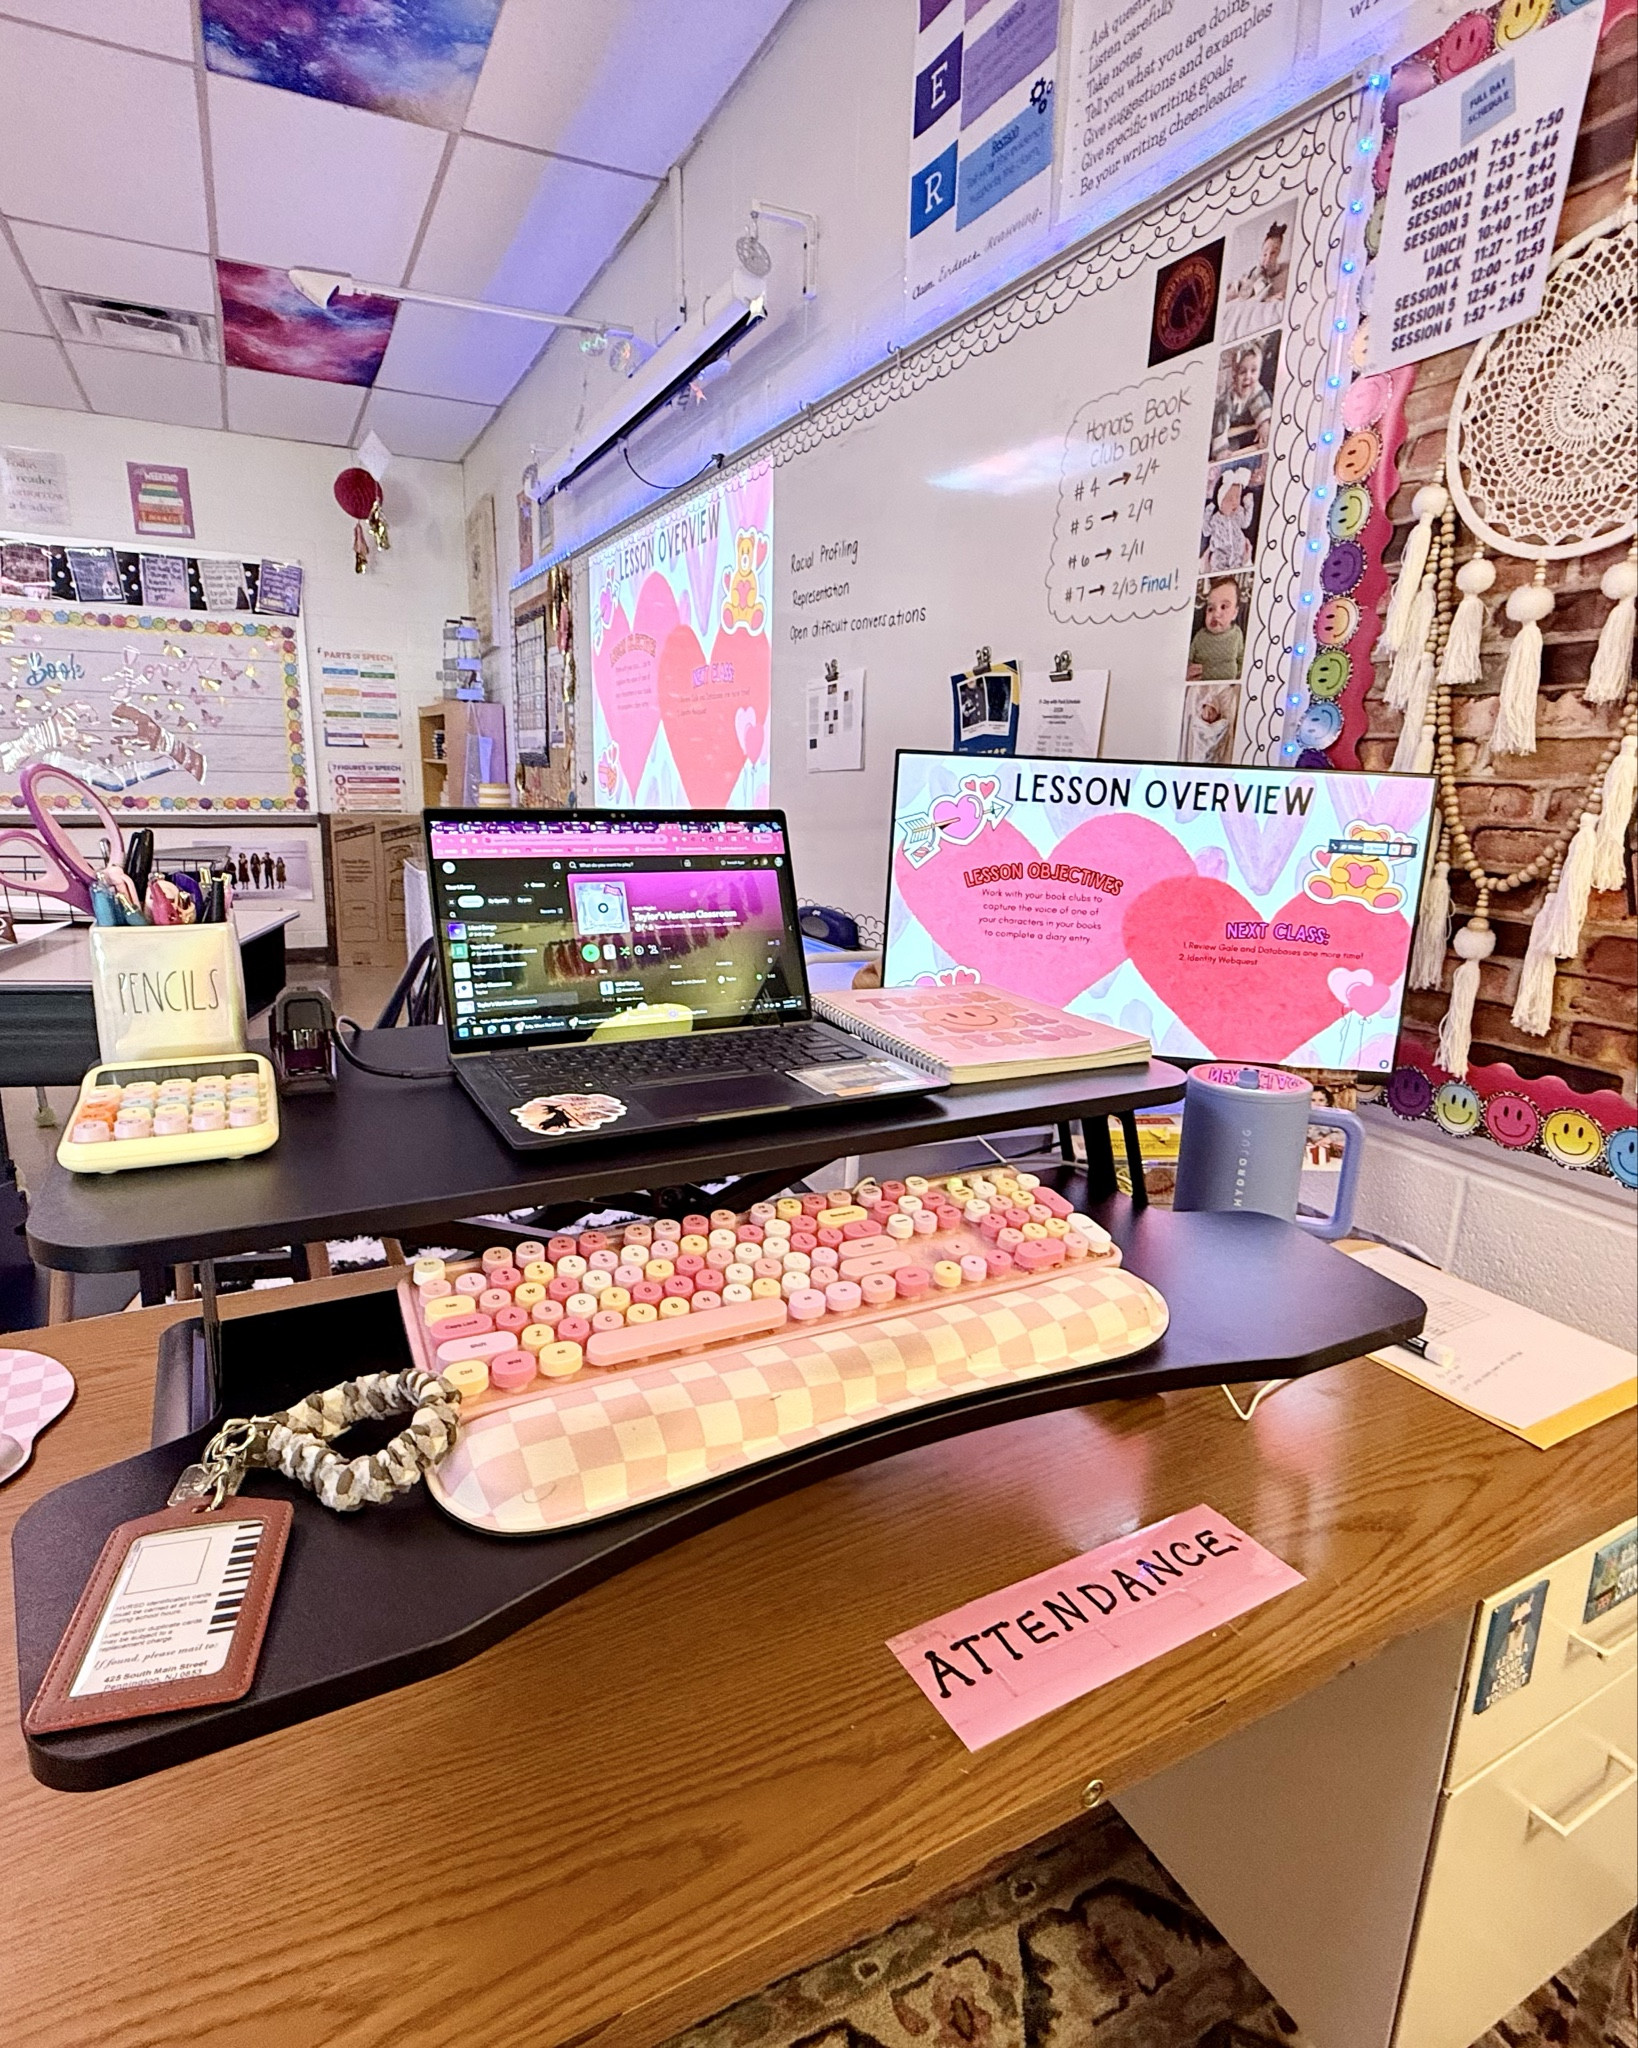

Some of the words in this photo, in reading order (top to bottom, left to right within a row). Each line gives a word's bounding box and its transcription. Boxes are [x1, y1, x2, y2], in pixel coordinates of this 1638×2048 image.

[1089, 20, 1109, 51] Ask
[1082, 123, 1107, 148] Give
[1107, 71, 1176, 128] suggestions
[1178, 46, 1204, 79] and
[1205, 2, 1274, 60] examples
[1084, 96, 1103, 123] Tell
[1103, 84, 1125, 113] you
[1126, 59, 1156, 89] what
[1158, 41, 1183, 72] you
[1185, 22, 1207, 49] are
[1208, 0, 1250, 30] doing
[1086, 73, 1110, 99] Take
[1112, 46, 1143, 79] notes
[1089, 40, 1121, 74] Listen
[930, 60, 948, 110] E
[1469, 91, 1488, 109] FULL
[1489, 77, 1506, 96] DAY
[1081, 147, 1102, 173] Give
[1105, 115, 1148, 156] specific
[1149, 82, 1197, 122] writing
[1198, 54, 1234, 96] goals
[1467, 90, 1510, 125] SCHEDULE
[1079, 174, 1094, 197] Be
[1095, 160, 1121, 190] your
[1122, 126, 1167, 166] writing
[1168, 75, 1247, 137] cheerleader
[1404, 147, 1480, 195] HOMEROOM
[1490, 128, 1521, 156] 7:45
[1535, 107, 1565, 135] 7:50
[924, 171, 944, 215] R
[1406, 195, 1462, 232] SESSION
[1463, 191, 1473, 208] 2
[1483, 173, 1514, 200] 8:49
[1525, 152, 1556, 180] 9:42
[1411, 174, 1467, 211] SESSION
[1469, 168, 1477, 185] 1
[1487, 151, 1516, 178] 7:53
[1403, 217, 1458, 252] SESSION
[1460, 212, 1470, 229] 3
[1479, 195, 1510, 221] 9:45
[1523, 171, 1557, 201] 10:38
[1422, 233, 1467, 264] LUNCH
[1477, 214, 1512, 242] 10:40
[1524, 192, 1556, 222] 11:25
[1425, 254, 1463, 282] PACK
[1473, 237, 1505, 264] 11:27
[1516, 217, 1547, 245] 11:57
[1394, 280, 1448, 313] SESSION
[1449, 276, 1459, 292] 4
[1470, 258, 1502, 285] 12:00
[1514, 237, 1546, 266] 12:53
[1392, 300, 1446, 333] SESSION
[1447, 296, 1457, 313] 5
[1466, 280, 1498, 306] 12:56
[1509, 263, 1536, 287] 1:49
[1391, 320, 1443, 352] SESSION
[1444, 317, 1453, 333] 6
[1462, 304, 1487, 327] 1:52
[1496, 287, 1526, 314] 2:45
[1085, 411, 1135, 445] Honors
[1143, 385, 1193, 426] Book
[1128, 418, 1182, 457] Dates
[1134, 457, 1161, 486] 2/4
[1127, 498, 1155, 523] 2/9
[619, 535, 655, 582] LESSON
[658, 500, 721, 563] OVERVIEW
[790, 551, 815, 575] Racial
[819, 539, 860, 566] Profiling
[1120, 537, 1145, 563] 2/11
[792, 581, 851, 611] Representation
[1111, 576, 1138, 601] 2/13
[1139, 567, 1180, 594] Final!
[789, 624, 809, 645] Open
[811, 619, 849, 638] difficult
[850, 606, 927, 632] conversations
[323, 651, 352, 660] PARTS
[361, 653, 394, 662] SPEECH
[1014, 773, 1132, 808] LESSON
[1144, 780, 1315, 817] OVERVIEW
[963, 862, 1023, 889] LESSON
[1027, 861, 1124, 897] OBJECTIVES
[981, 888, 1003, 897] Work
[1004, 890, 1023, 898] with
[1024, 891, 1043, 901] your
[1045, 891, 1067, 901] book
[1068, 893, 1092, 903] clubs
[1093, 895, 1103, 904] to
[631, 910, 666, 922] Taylor's
[666, 909, 696, 921] Version
[695, 908, 738, 920] Classroom
[978, 916, 997, 926] your
[998, 915, 1044, 927] characters
[1045, 917, 1054, 926] in
[1055, 920, 1074, 930] your
[1076, 920, 1102, 931] books
[982, 902, 1017, 912] capture
[1018, 904, 1033, 913] the
[1034, 905, 1058, 914] voice
[1059, 905, 1069, 915] of
[1070, 908, 1088, 916] one
[1089, 907, 1099, 917] of
[984, 929, 994, 937] to
[995, 929, 1035, 941] complete
[1037, 932, 1043, 940] a
[1045, 931, 1067, 943] diary
[1188, 940, 1217, 951] Review
[1218, 943, 1239, 953] Gale
[1240, 944, 1256, 954] and
[1257, 945, 1301, 957] Databases
[1302, 950, 1319, 958] one
[1320, 951, 1342, 959] more
[1343, 951, 1365, 961] time!
[1225, 921, 1270, 940] NEXT
[1273, 922, 1331, 946] CLASS:
[1186, 953, 1217, 965] Identity
[1218, 955, 1258, 966] Webquest
[117, 968, 220, 1016] PENCILS
[1232, 1128, 1253, 1208] HYDROJUG
[924, 1529, 1239, 1699] ATTENDANCE
[103, 1673, 122, 1684] 425
[123, 1669, 153, 1681] South
[153, 1665, 178, 1676] Main
[178, 1659, 209, 1671] Street
[141, 1649, 177, 1664] please
[177, 1642, 205, 1655] mail
